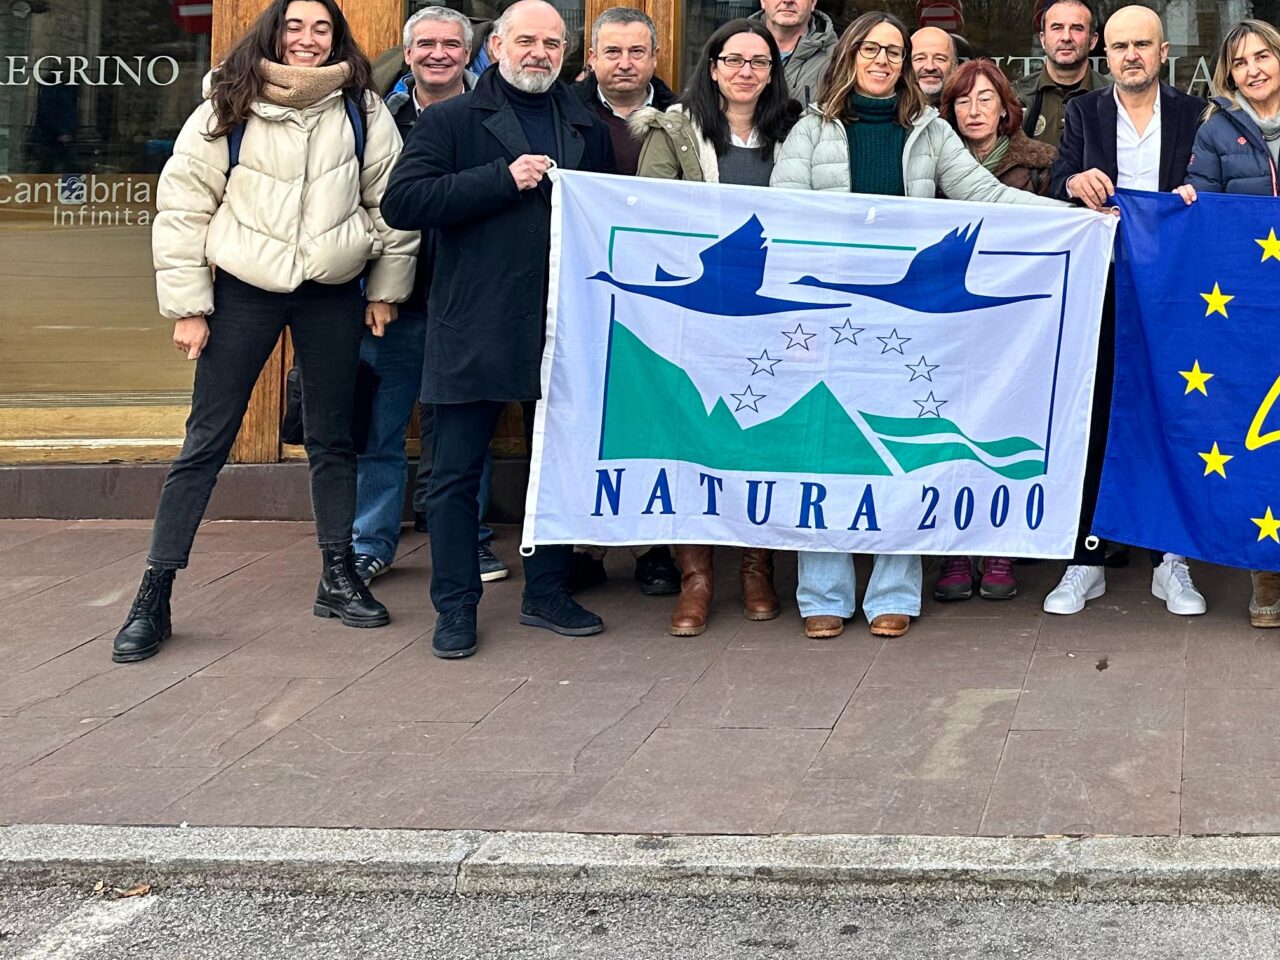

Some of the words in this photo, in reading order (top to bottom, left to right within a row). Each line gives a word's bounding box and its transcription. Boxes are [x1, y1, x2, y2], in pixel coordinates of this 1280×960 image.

[0, 55, 179, 86] EGRINO
[0, 174, 151, 204] Cantabria
[53, 205, 150, 226] Infinita
[590, 467, 882, 532] NATURA
[916, 482, 1045, 531] 2000
